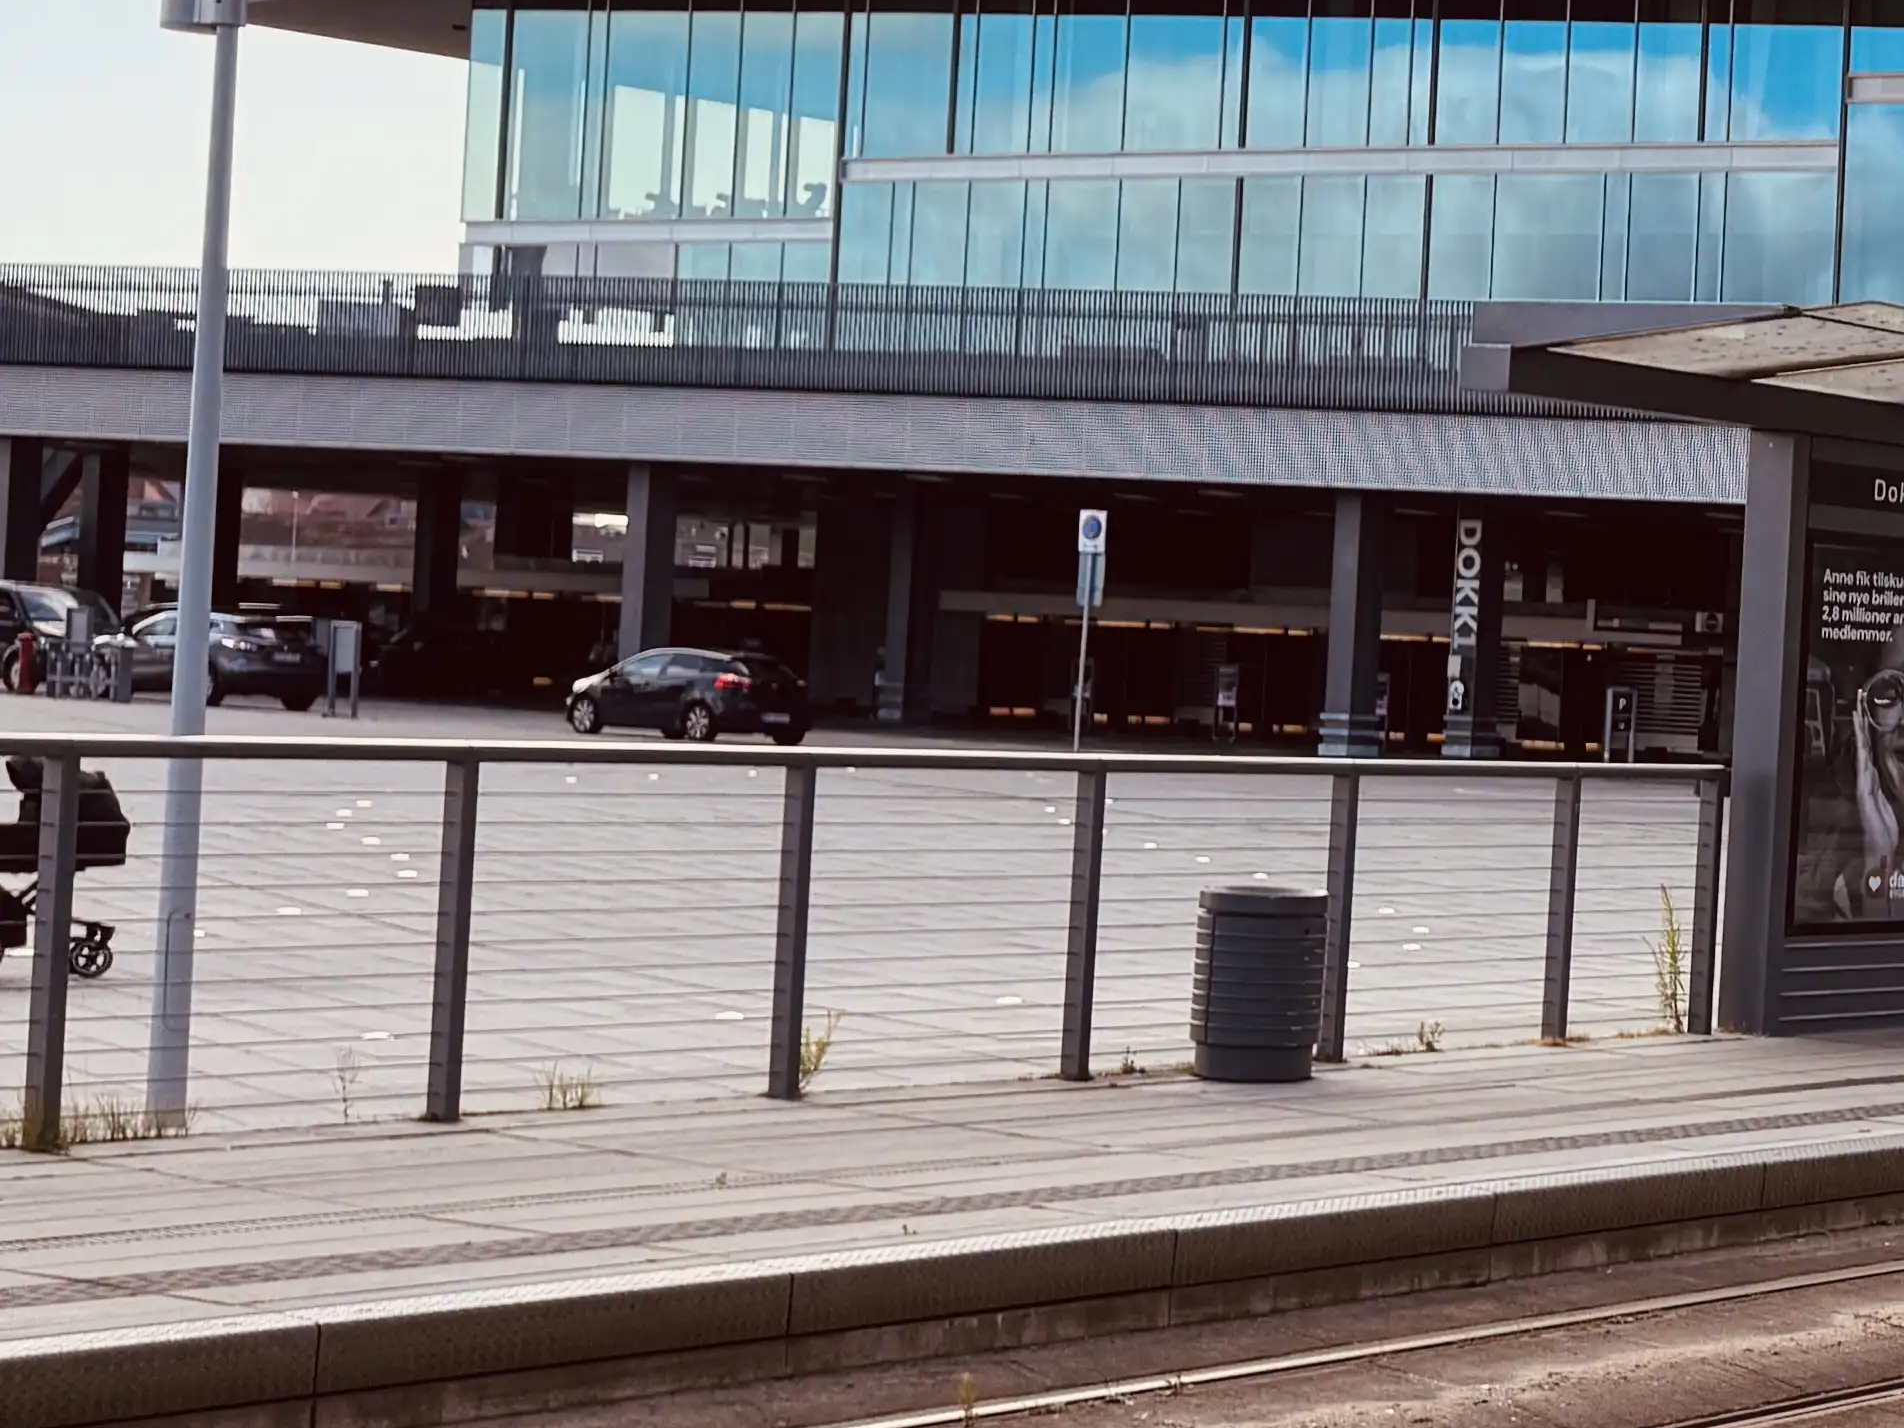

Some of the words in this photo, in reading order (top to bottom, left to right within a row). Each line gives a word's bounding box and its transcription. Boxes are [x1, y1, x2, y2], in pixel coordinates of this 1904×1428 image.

[1453, 519, 1482, 650] DOKK1
[1823, 568, 1854, 585] Anne
[1856, 570, 1870, 586] fik
[1823, 588, 1847, 603] sine
[1849, 593, 1870, 607] nye
[1872, 591, 1904, 607] briller
[1822, 606, 1840, 622] 2,8
[1841, 606, 1891, 623] millioner
[1821, 624, 1894, 642] medlemmer.
[1619, 698, 1627, 711] P
